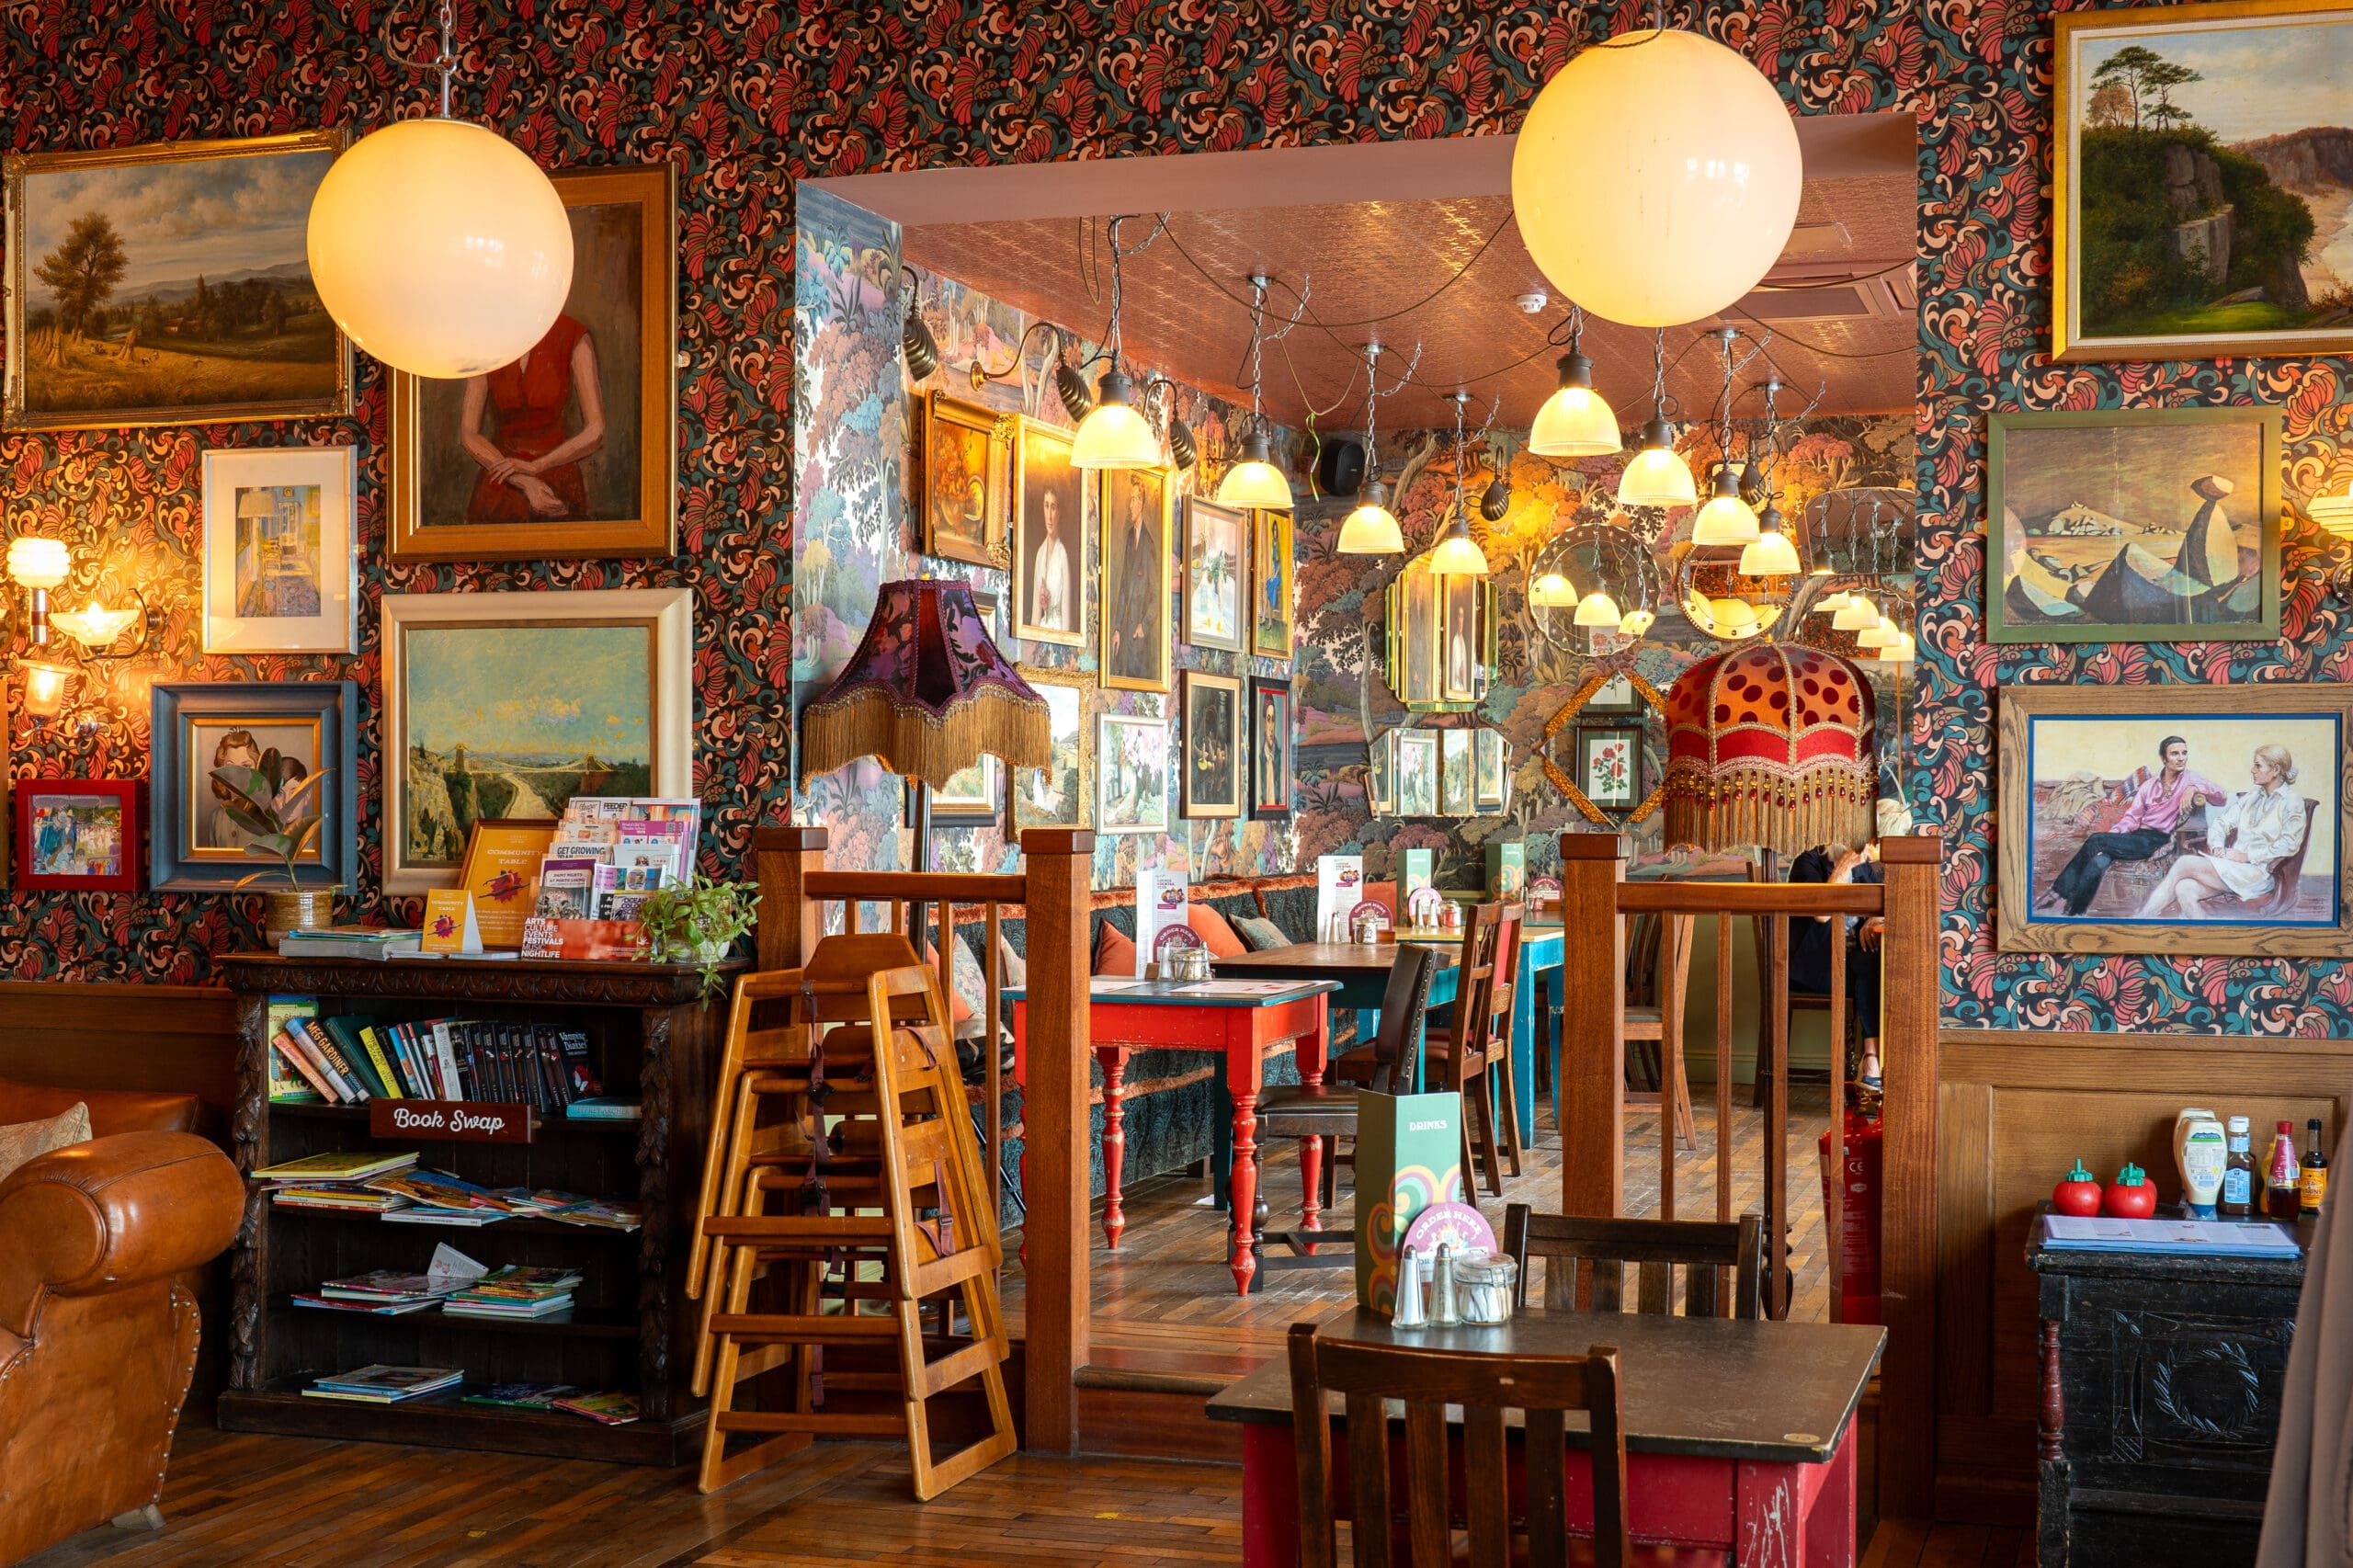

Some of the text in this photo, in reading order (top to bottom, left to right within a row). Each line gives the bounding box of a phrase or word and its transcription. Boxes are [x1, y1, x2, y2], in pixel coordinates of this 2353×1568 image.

[557, 846, 606, 855] GET GROWING
[525, 917, 546, 926] ARTS
[1160, 927, 1179, 941] ORDER
[520, 949, 561, 959] NIGHTLIFE
[558, 1032, 586, 1042] Vampire
[306, 1021, 349, 1077] MEG GARDINER
[563, 1040, 588, 1051] Diaries
[393, 1108, 506, 1135] Book Swap
[1409, 1119, 1449, 1132] DRINKS
[1415, 1210, 1483, 1240] ORDER HERE
